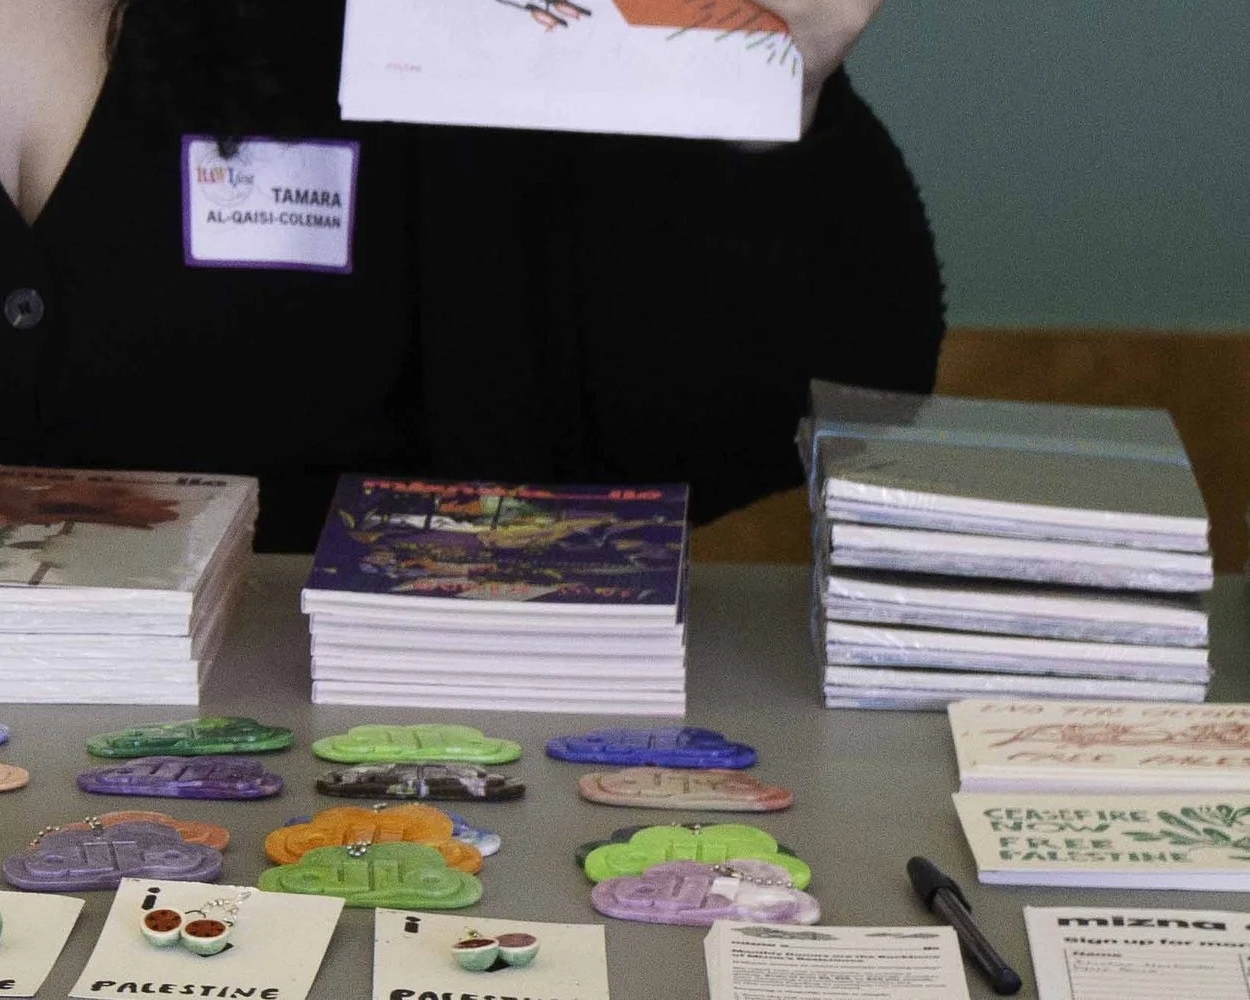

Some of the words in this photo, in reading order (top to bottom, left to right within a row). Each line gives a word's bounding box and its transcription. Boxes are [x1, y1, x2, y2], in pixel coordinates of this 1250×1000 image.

[271, 187, 342, 208] TAMARA
[207, 210, 341, 229] AL-QAISI-COLEMAN
[983, 807, 1150, 822] CEASEFIRE
[990, 820, 1111, 833] NOW
[999, 836, 1114, 850] FREE
[999, 850, 1192, 862] PALESTINE
[1057, 916, 1226, 931] mizna
[90, 980, 279, 1000] PALESTINE
